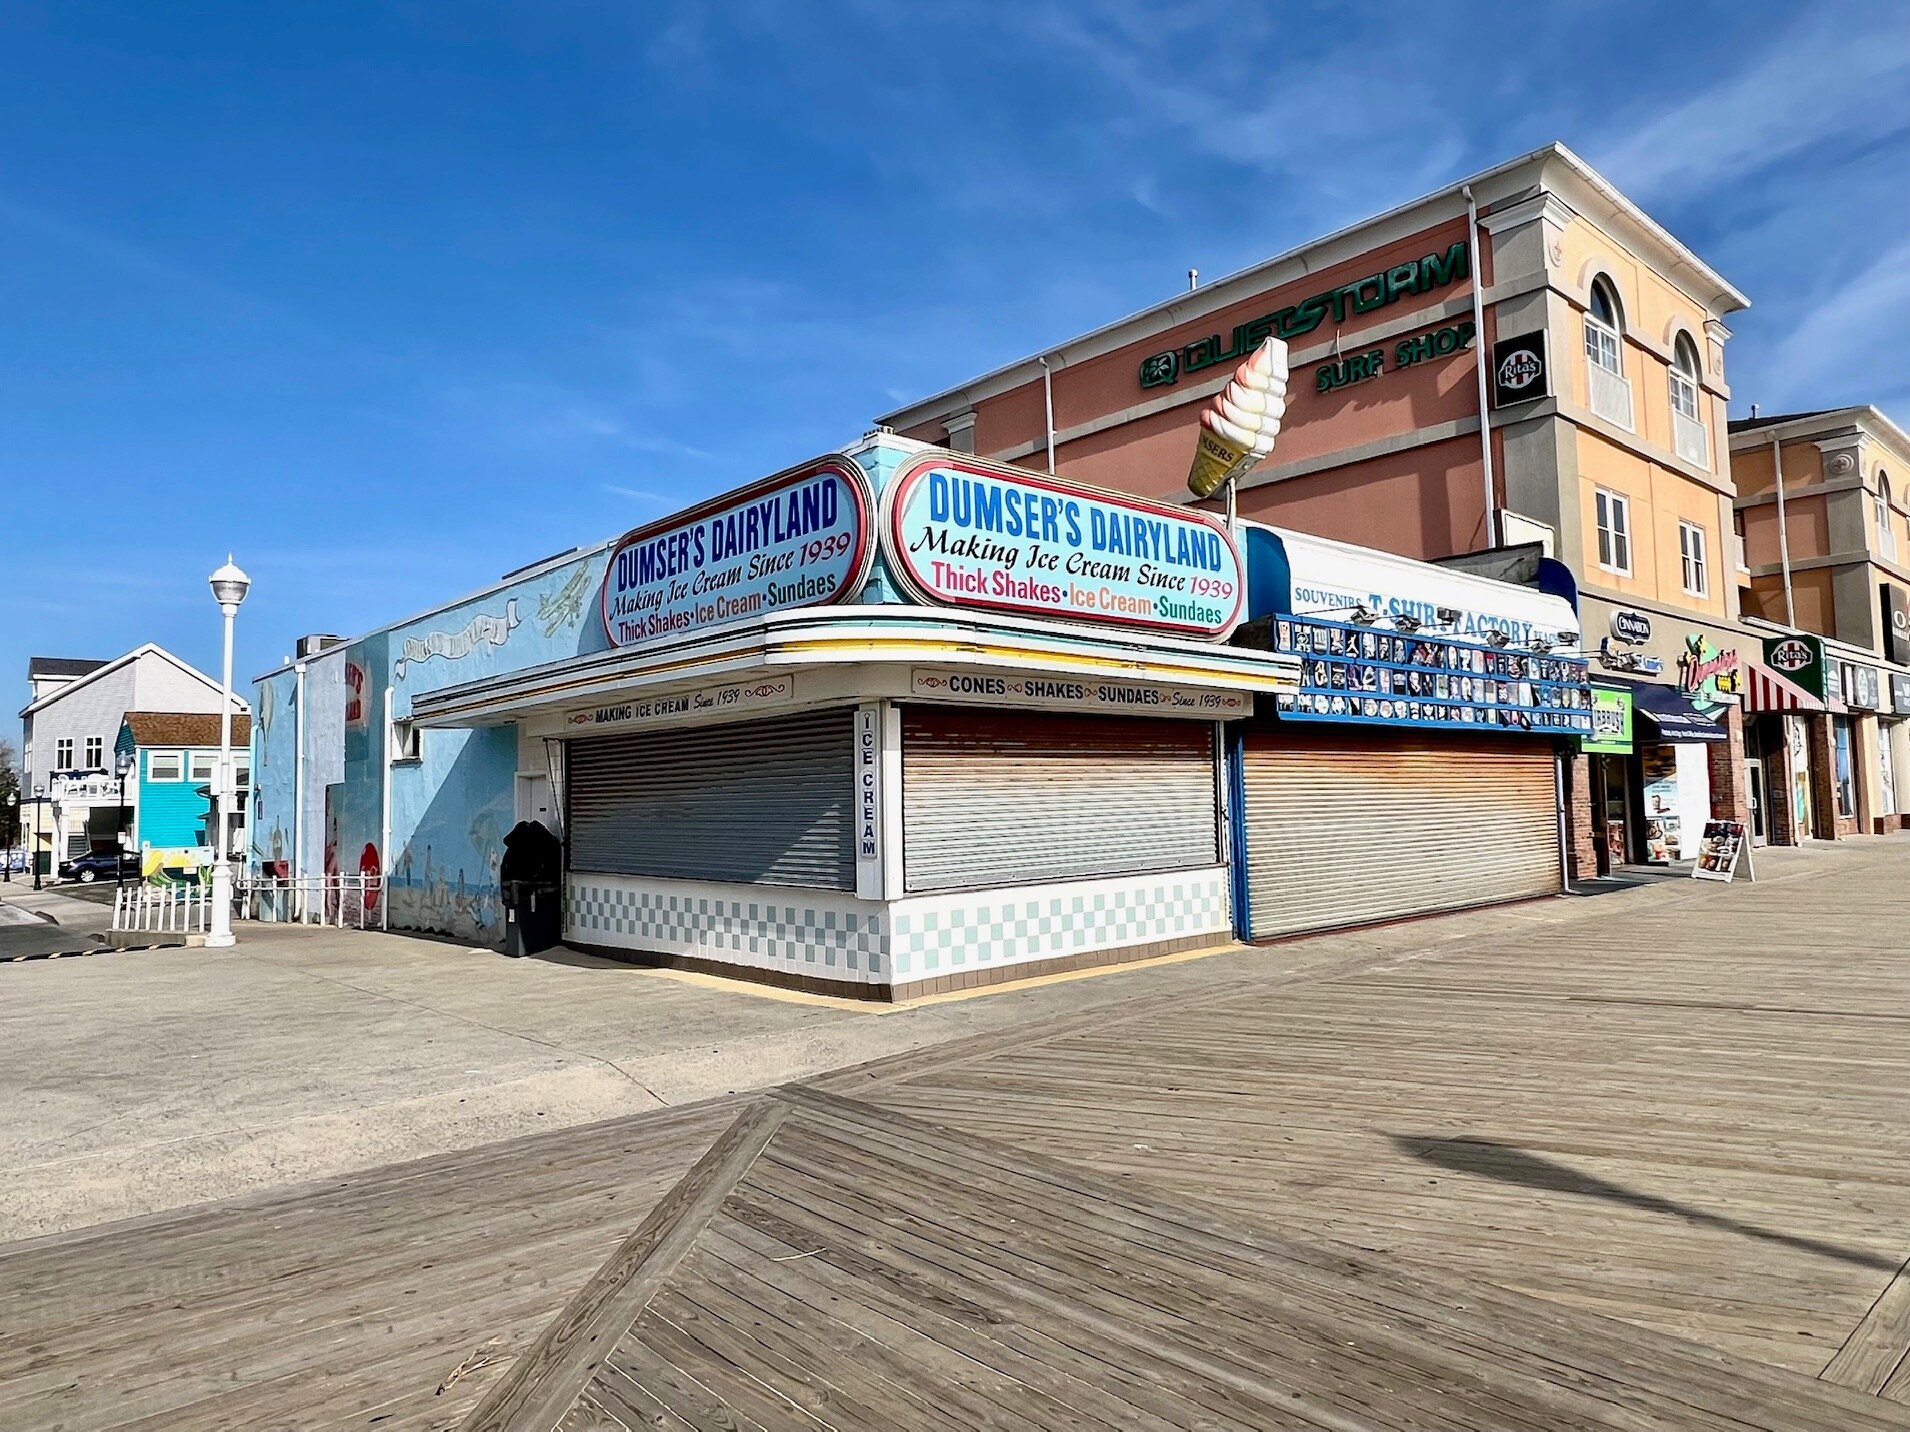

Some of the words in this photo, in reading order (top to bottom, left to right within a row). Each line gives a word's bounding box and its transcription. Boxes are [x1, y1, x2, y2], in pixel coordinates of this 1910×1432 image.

[1315, 348, 1384, 391] SURF
[1395, 321, 1475, 367] SHOP
[1505, 361, 1537, 378] Rita's
[618, 524, 705, 592] DUMSER'S
[712, 478, 837, 563] DAIRYLAND
[928, 472, 1081, 547] DUMSER'S
[1090, 506, 1221, 572] DAIRYLAND
[609, 595, 663, 621] Making
[667, 579, 688, 601] Ice
[692, 565, 741, 595] Cream
[747, 550, 794, 580] Since
[799, 531, 851, 568] 1939
[910, 526, 1020, 570] Making
[1025, 544, 1058, 570] Ice
[1065, 551, 1131, 583] Cream
[1136, 564, 1186, 592] Since
[1189, 576, 1234, 600] 1939
[931, 561, 989, 594] Thick
[992, 571, 1061, 603] Shakes
[1069, 582, 1096, 607] Ice
[1099, 587, 1152, 616] Cream
[1159, 595, 1222, 625] Sundaes
[618, 619, 647, 643] Thick
[649, 612, 690, 635] Shakes
[695, 603, 715, 624] Ice
[717, 592, 761, 619] Cream
[768, 573, 837, 607] Sundaes
[1295, 587, 1362, 607] SOUVENIRS
[1368, 593, 1447, 632] T-SHIR
[1777, 650, 1807, 661] Rita's
[595, 705, 632, 723] MAKING
[635, 703, 651, 717] ICE
[654, 701, 689, 715] CREAM
[693, 693, 714, 710] Since
[716, 688, 741, 705] 1939
[949, 675, 1006, 694] CONES
[1024, 682, 1084, 700] SHAKES
[1098, 686, 1160, 705] SUNDAES
[1171, 691, 1196, 707] Since
[1198, 694, 1222, 708] 1939
[862, 713, 873, 765] ICE
[862, 774, 875, 854] CREAM
